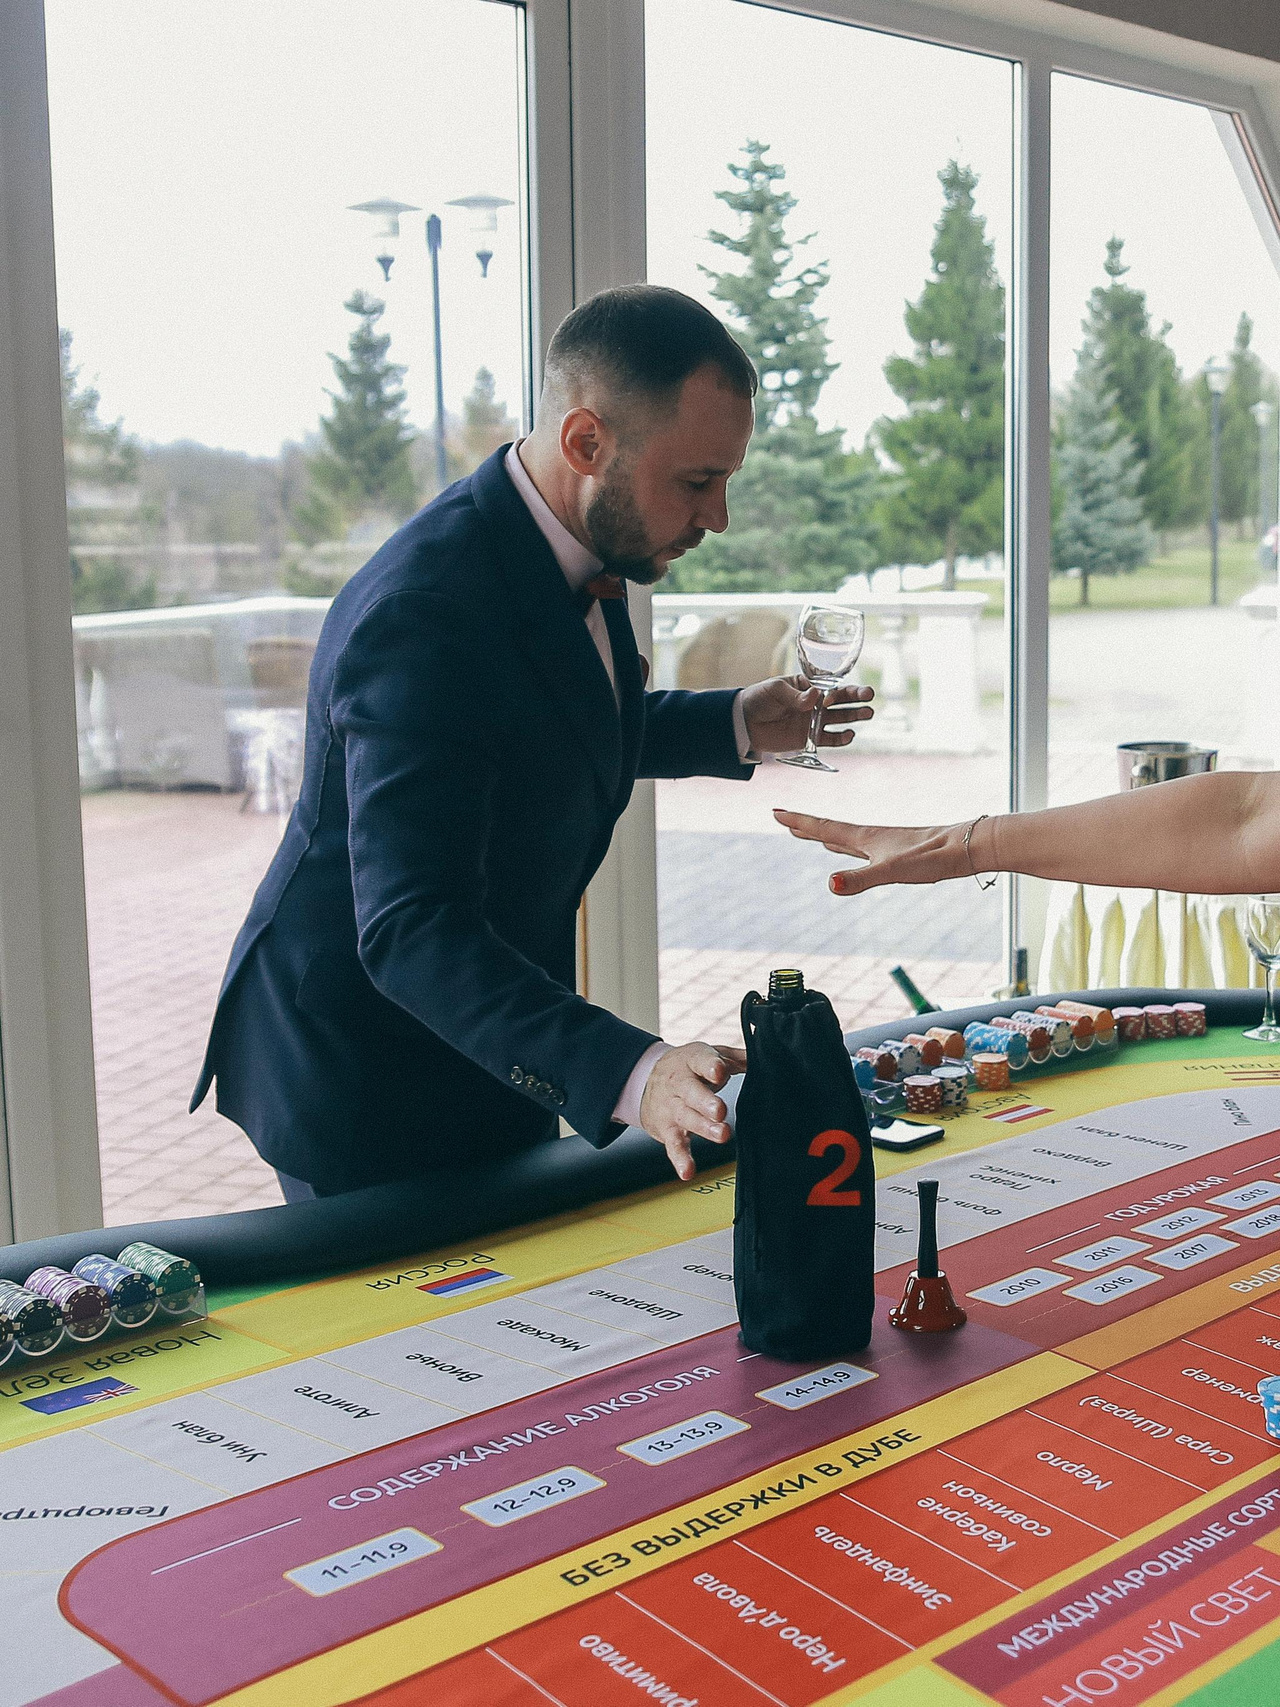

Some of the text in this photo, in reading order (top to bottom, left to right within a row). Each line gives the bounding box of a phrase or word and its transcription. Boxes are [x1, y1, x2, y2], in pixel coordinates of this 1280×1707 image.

[806, 1129, 861, 1207] 2
[1032, 1147, 1113, 1168] Вердехо
[969, 1173, 1031, 1191] Педро
[1104, 1175, 1229, 1223] ГОД УРОЖАЯ
[1234, 1187, 1269, 1202] 2013
[953, 1200, 1002, 1216] Фоль
[1161, 1215, 1199, 1231] 2012
[366, 1252, 496, 1291] Россия
[1084, 1246, 1121, 1262] 2011
[1174, 1243, 1210, 1262] 2017
[588, 1289, 684, 1321] Шардоне
[999, 1278, 1041, 1296] 2010
[1094, 1275, 1134, 1295] 2016
[85, 1330, 222, 1371] Новая
[497, 1319, 591, 1352] Мюскаде
[405, 1353, 483, 1383] Вионье
[1181, 1367, 1265, 1407] рменер
[294, 1385, 380, 1419] Алиготе
[172, 1420, 267, 1463] Уни блан
[328, 1364, 721, 1511] СОДЕРЖАНИЕ АЛКОГОЛЯ
[1079, 1395, 1235, 1466] Сира (Шираз)
[1036, 1450, 1113, 1492] Мерло
[560, 1428, 922, 1587] БЕЗ ВЫДЕРЖКИ В ДУБЕ
[916, 1497, 1017, 1553] Каберне
[941, 1480, 1052, 1538] совиньон
[814, 1525, 953, 1611] Зинфандель
[996, 1521, 1237, 1658] МЕЖДУНАРОДНЫЕ
[779, 1625, 846, 1674] Неро
[1042, 1619, 1201, 1707] НОВЫЙ
[579, 1634, 701, 1707] римитиво
